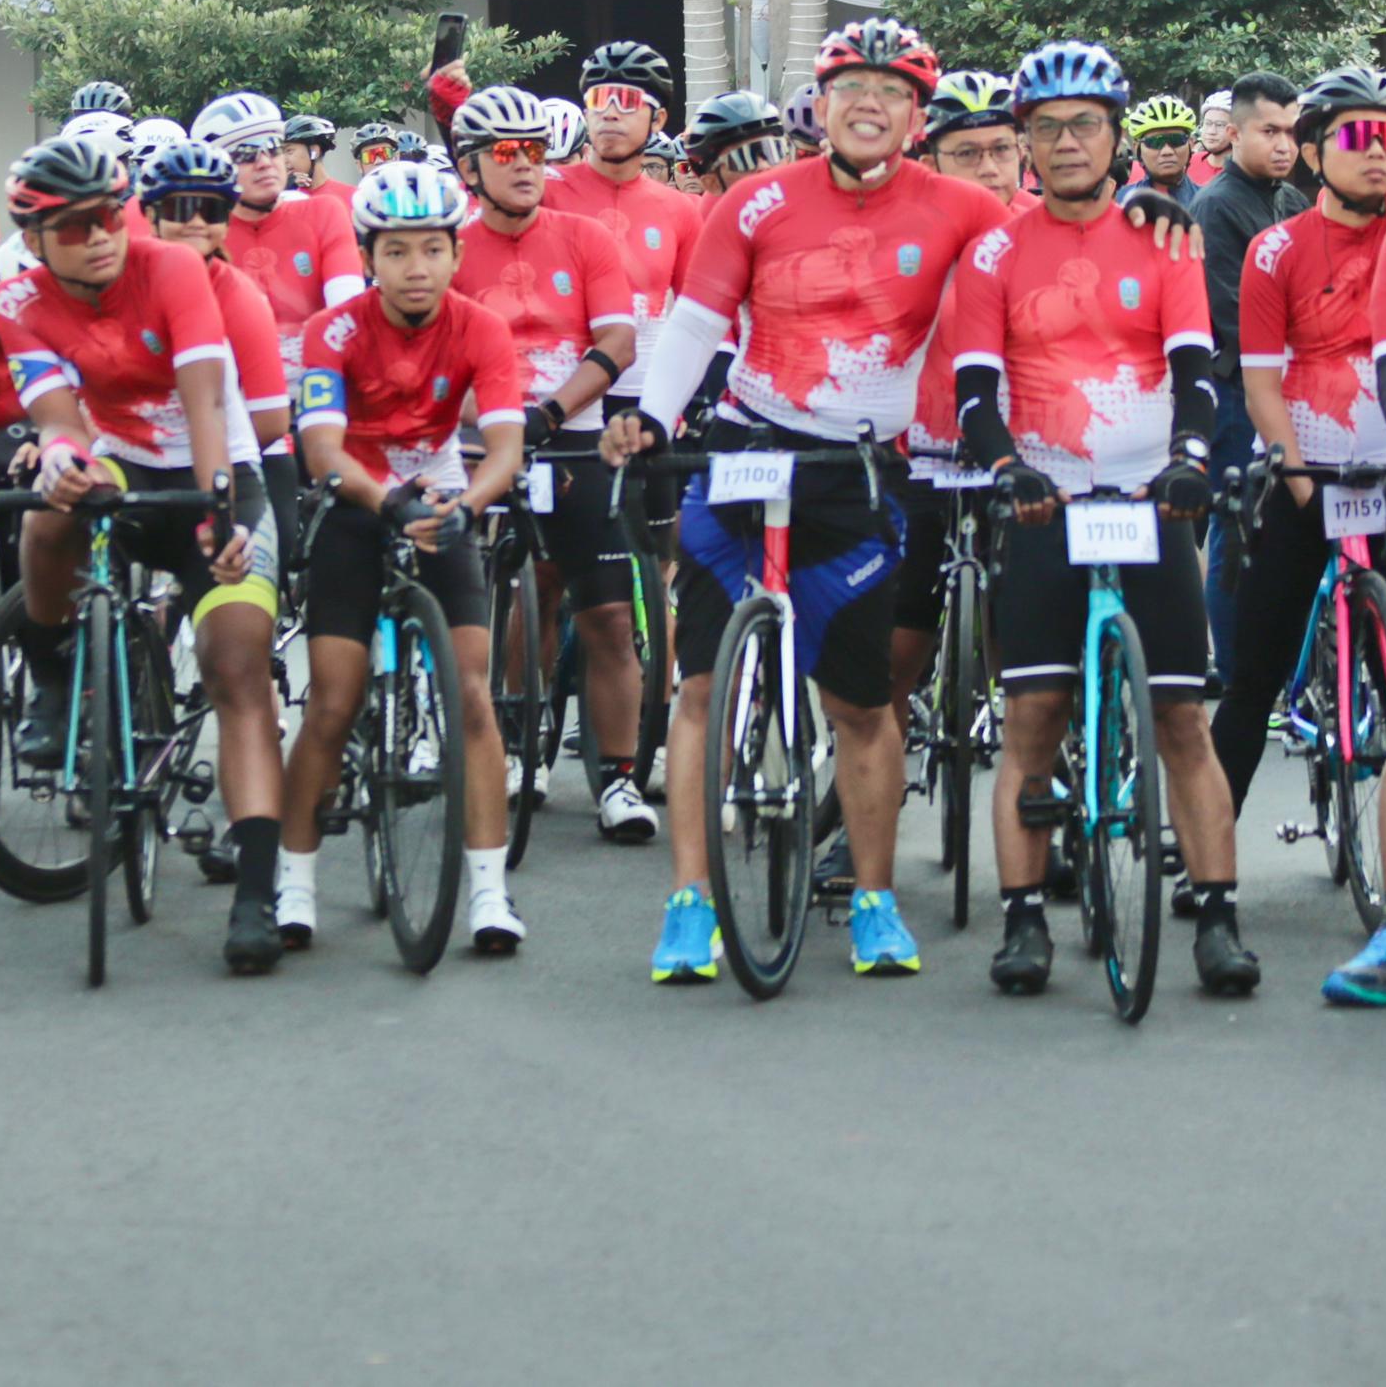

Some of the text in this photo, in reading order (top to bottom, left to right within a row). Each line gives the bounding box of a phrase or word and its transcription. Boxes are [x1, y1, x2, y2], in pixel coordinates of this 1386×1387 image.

[738, 180, 784, 239] CNN
[972, 227, 1011, 275] CNN
[1254, 224, 1291, 275] CNN
[297, 373, 333, 413] C
[723, 466, 779, 486] 17100
[1335, 498, 1383, 519] 17159
[1086, 523, 1137, 540] 17110
